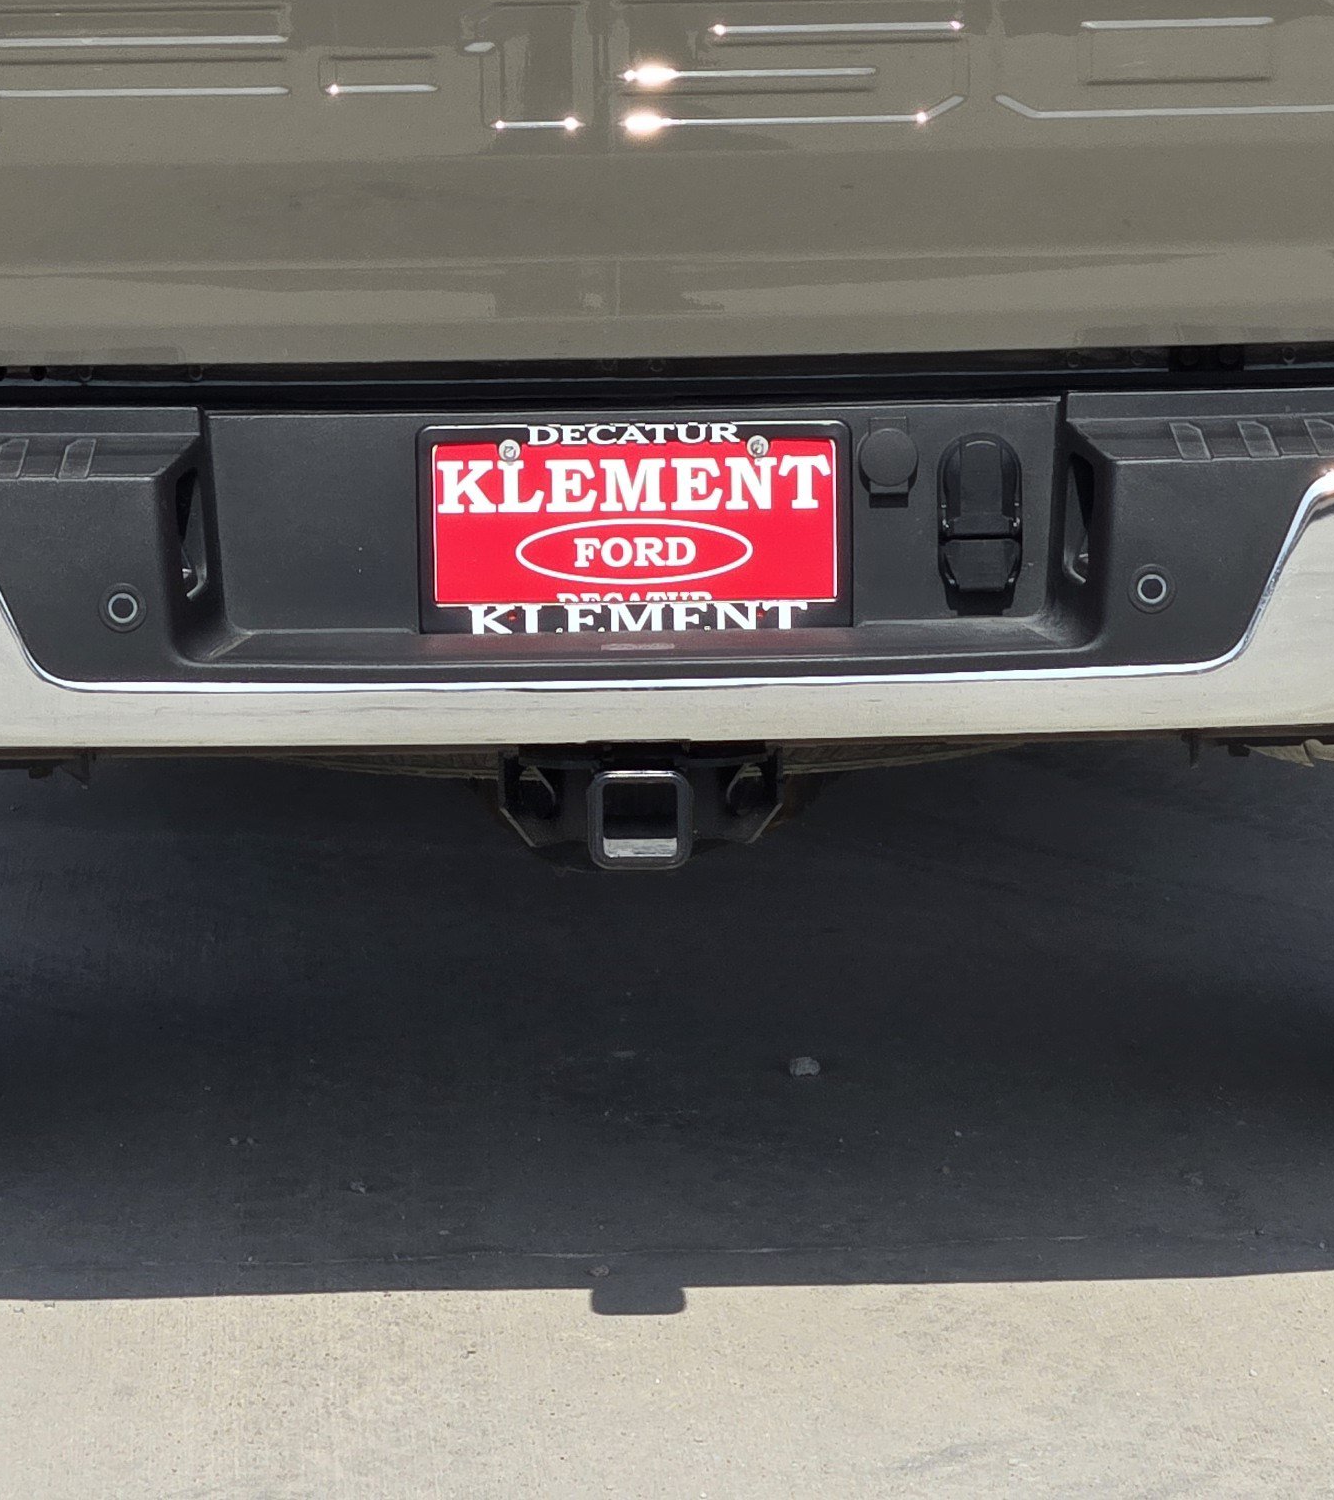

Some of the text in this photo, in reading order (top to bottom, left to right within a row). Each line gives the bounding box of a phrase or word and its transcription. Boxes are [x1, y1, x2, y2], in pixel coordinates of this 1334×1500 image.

[527, 422, 741, 446] DECATUR
[436, 455, 832, 514] KLEMENT
[574, 537, 697, 568] FORD
